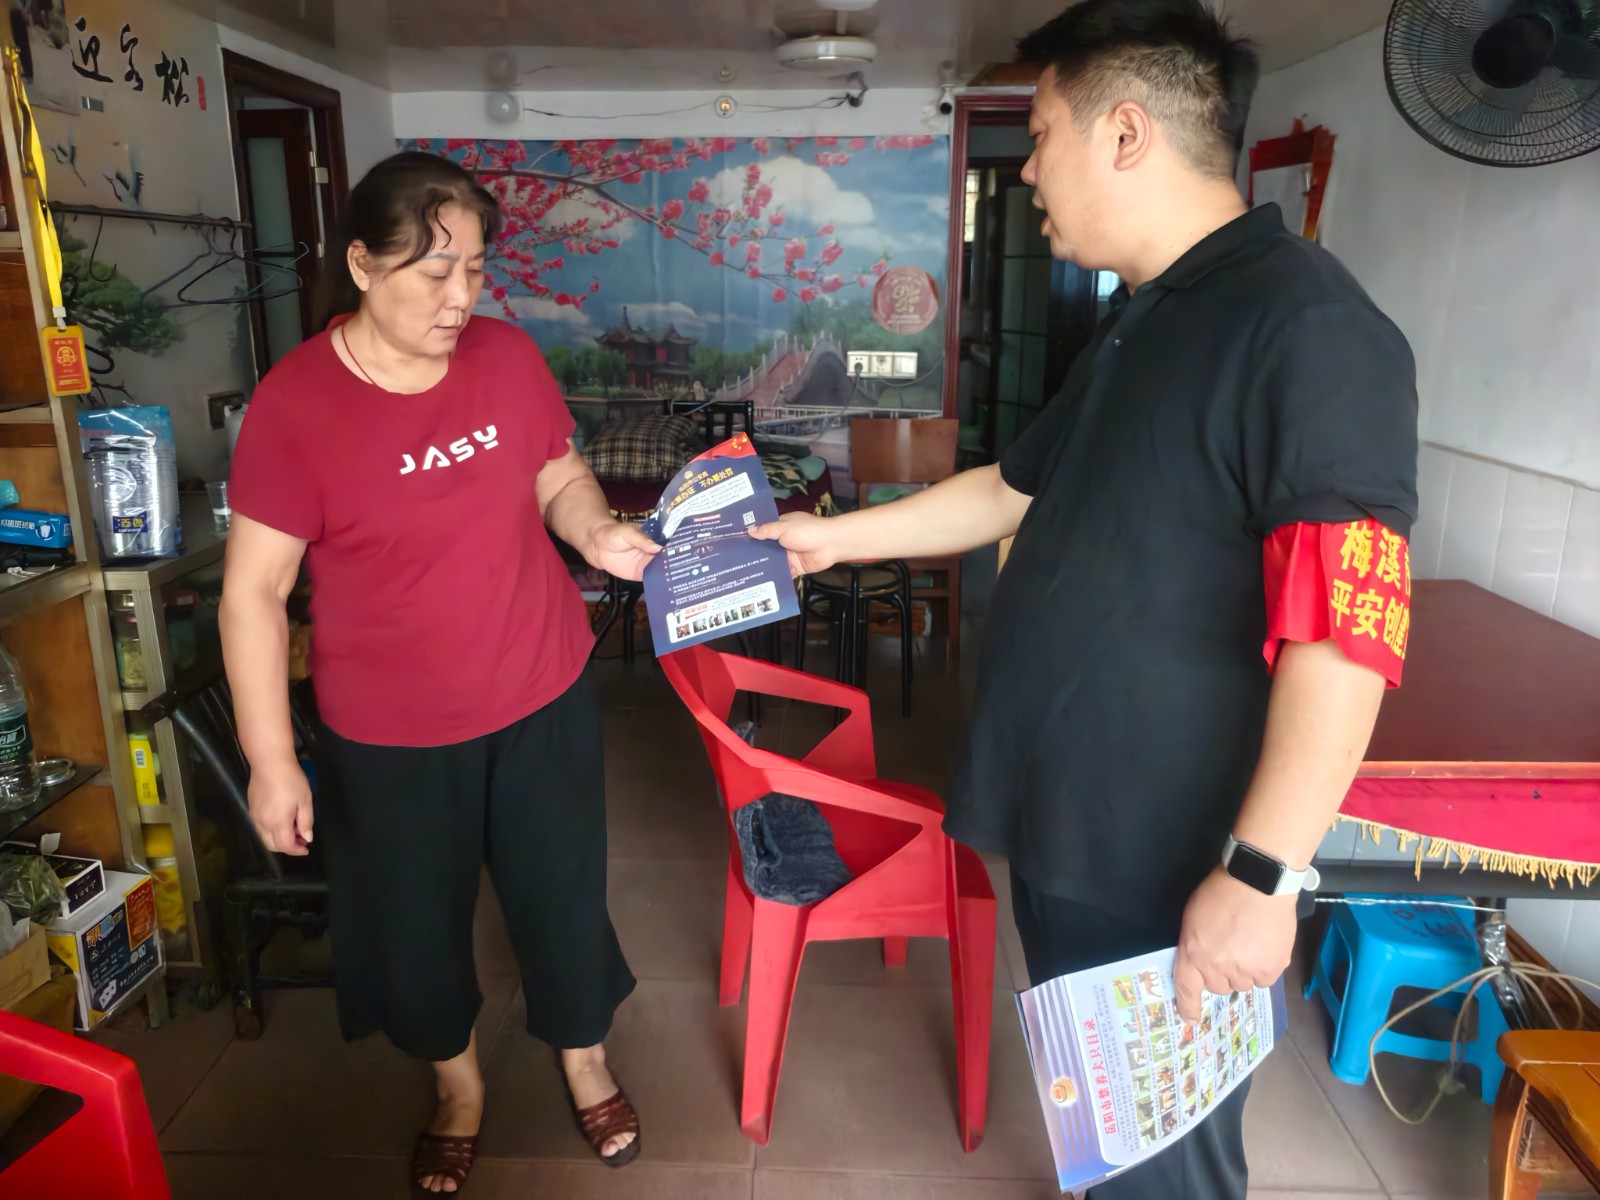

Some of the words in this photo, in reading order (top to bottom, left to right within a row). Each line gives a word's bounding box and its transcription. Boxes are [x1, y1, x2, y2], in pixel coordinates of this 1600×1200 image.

[399, 424, 499, 475] JASY
[1083, 1018, 1117, 1135] 岳阳市禁养犬只目录
